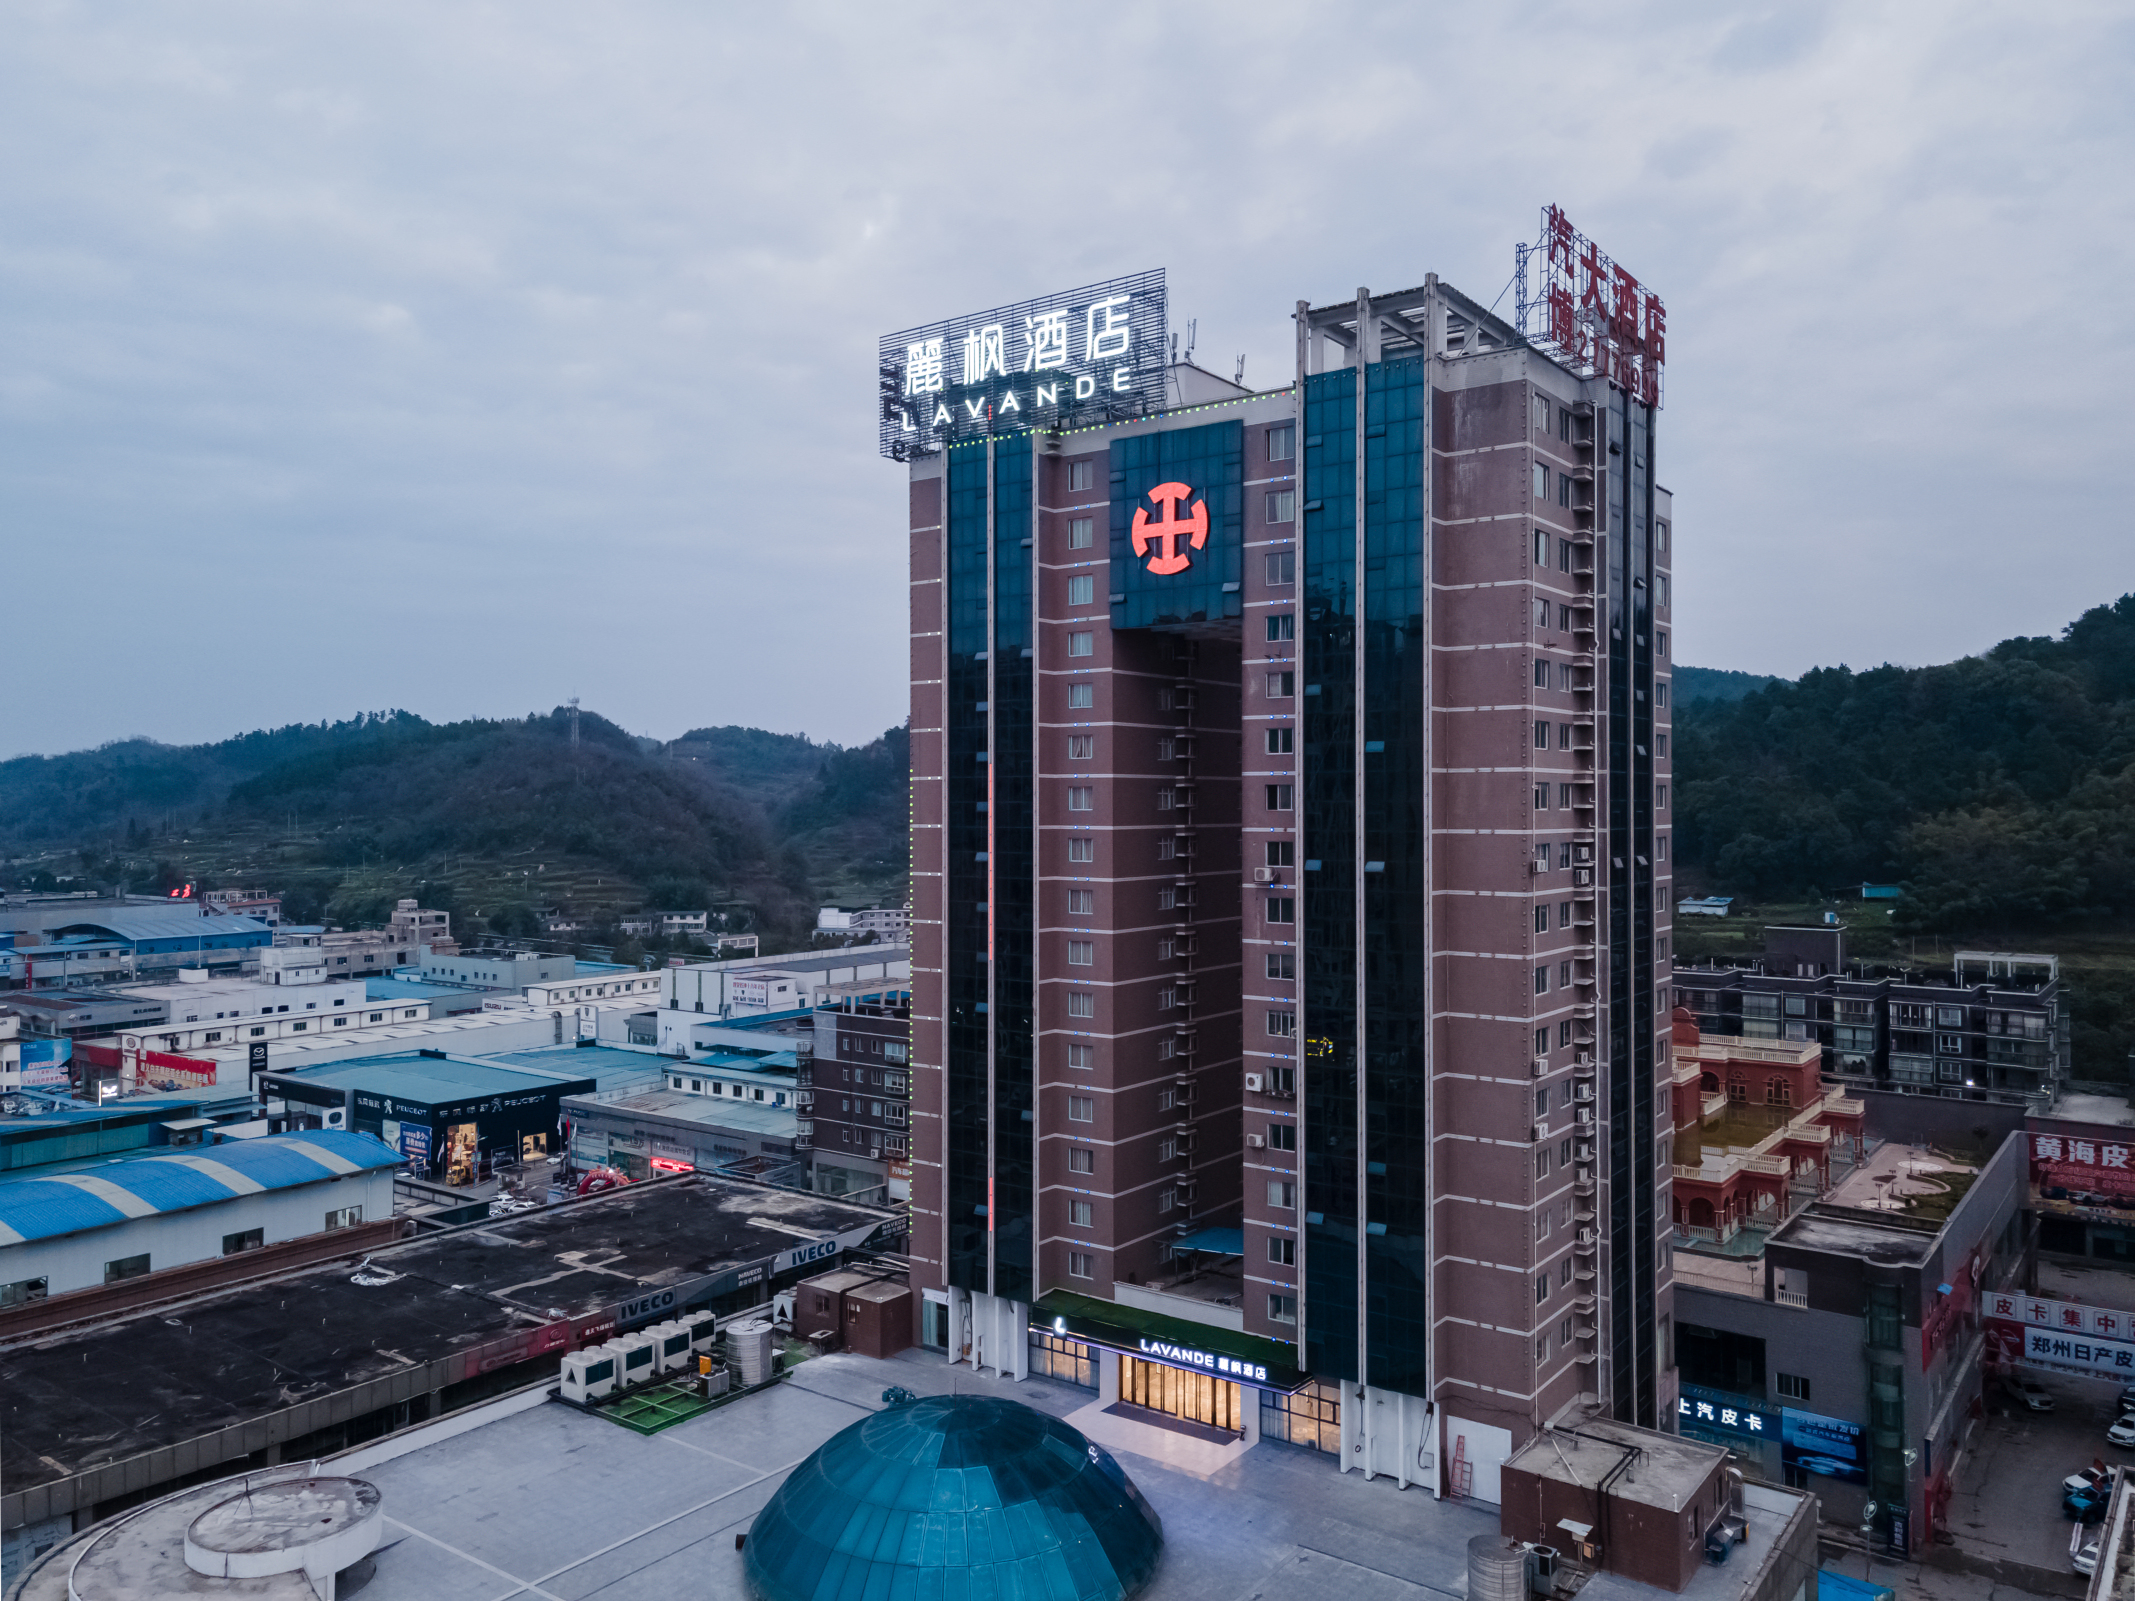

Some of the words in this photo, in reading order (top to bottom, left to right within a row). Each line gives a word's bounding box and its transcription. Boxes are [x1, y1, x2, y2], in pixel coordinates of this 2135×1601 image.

[903, 367, 1131, 432] LAVANDE
[2035, 1137, 2129, 1169] 黄海皮
[792, 1241, 837, 1265] IVECO
[621, 1292, 674, 1319] IVECO
[1995, 1298, 2135, 1337] 皮卡集中
[1140, 1338, 1215, 1368] LAVANDE
[2032, 1336, 2133, 1369] 郑州日产皮
[1679, 1397, 1763, 1431] 上汽皮卡
